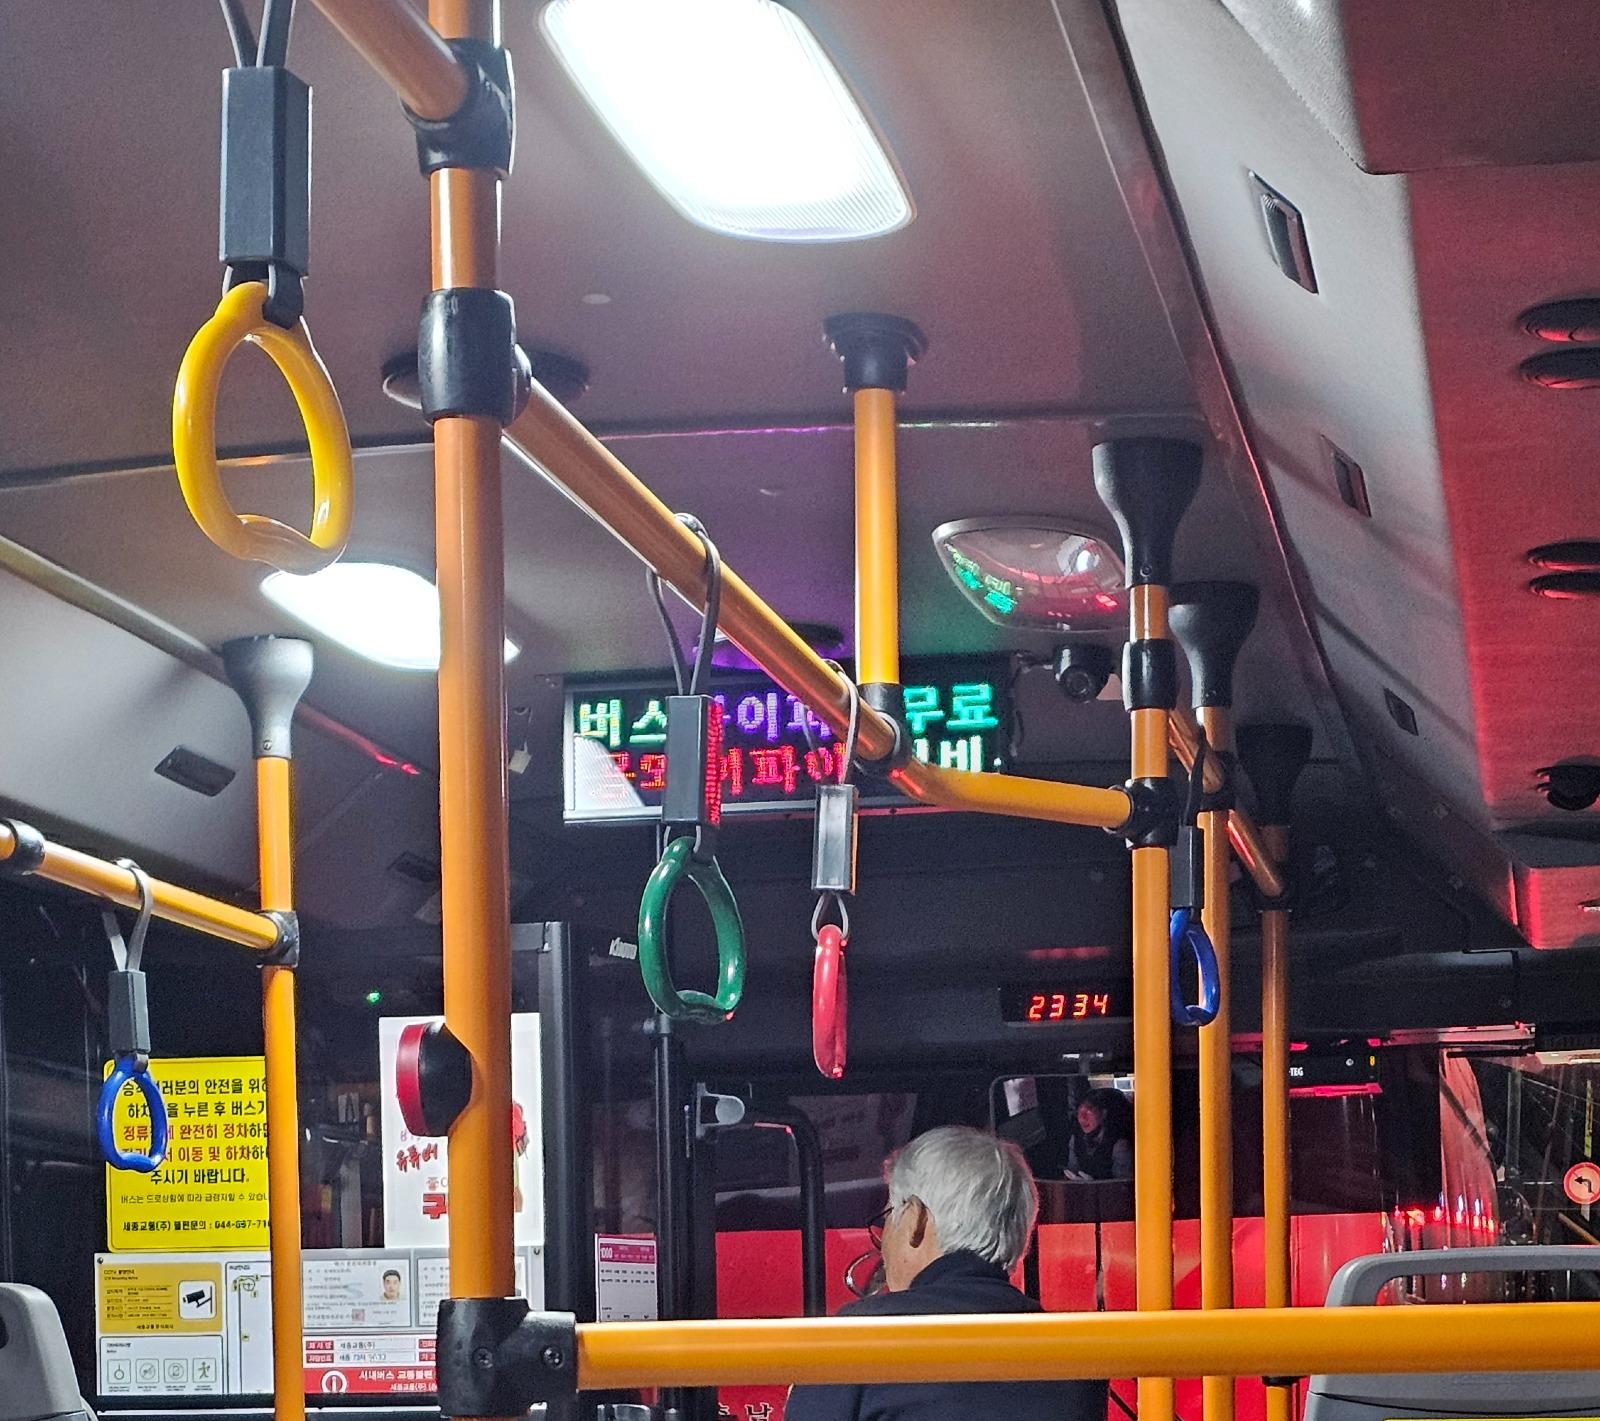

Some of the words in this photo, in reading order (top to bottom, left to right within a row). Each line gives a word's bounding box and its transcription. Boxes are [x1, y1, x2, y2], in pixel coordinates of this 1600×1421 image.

[903, 684, 998, 732] 무료
[123, 1079, 199, 1097] 승러분의
[205, 1078, 243, 1094] 안전을
[128, 1103, 179, 1118] 하차을
[184, 1101, 209, 1117] 누른
[214, 1101, 226, 1116] 후
[180, 1124, 217, 1140] 완전히
[178, 1146, 203, 1162] 이동
[208, 1146, 220, 1162] 및
[225, 1145, 268, 1161] 하차하
[151, 1169, 188, 1184] 주시기
[194, 1168, 250, 1183] 바랍니다.
[214, 1219, 271, 1230] 044-867-71
